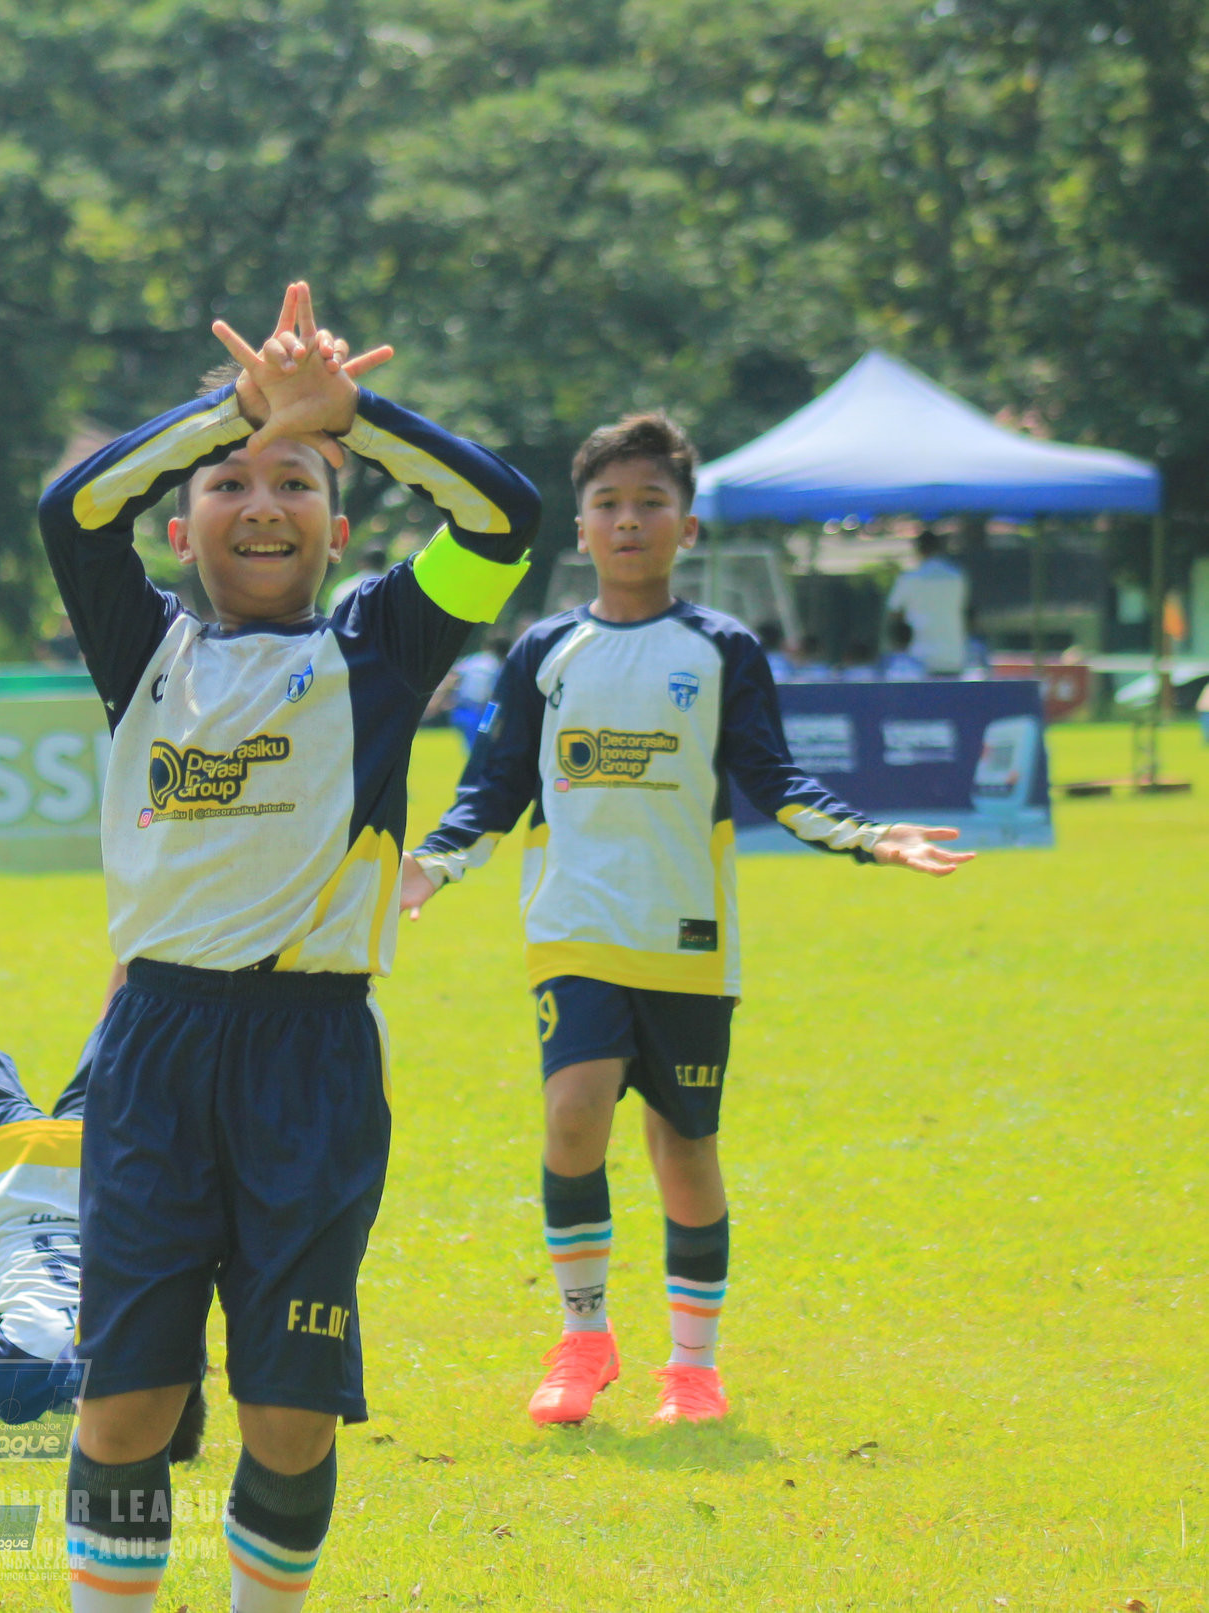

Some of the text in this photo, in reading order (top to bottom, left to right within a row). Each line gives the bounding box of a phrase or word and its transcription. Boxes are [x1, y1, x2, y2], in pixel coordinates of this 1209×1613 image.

[600, 733, 676, 750] Decorasiku
[600, 747, 648, 761] Inovasi
[600, 759, 643, 777] Group
